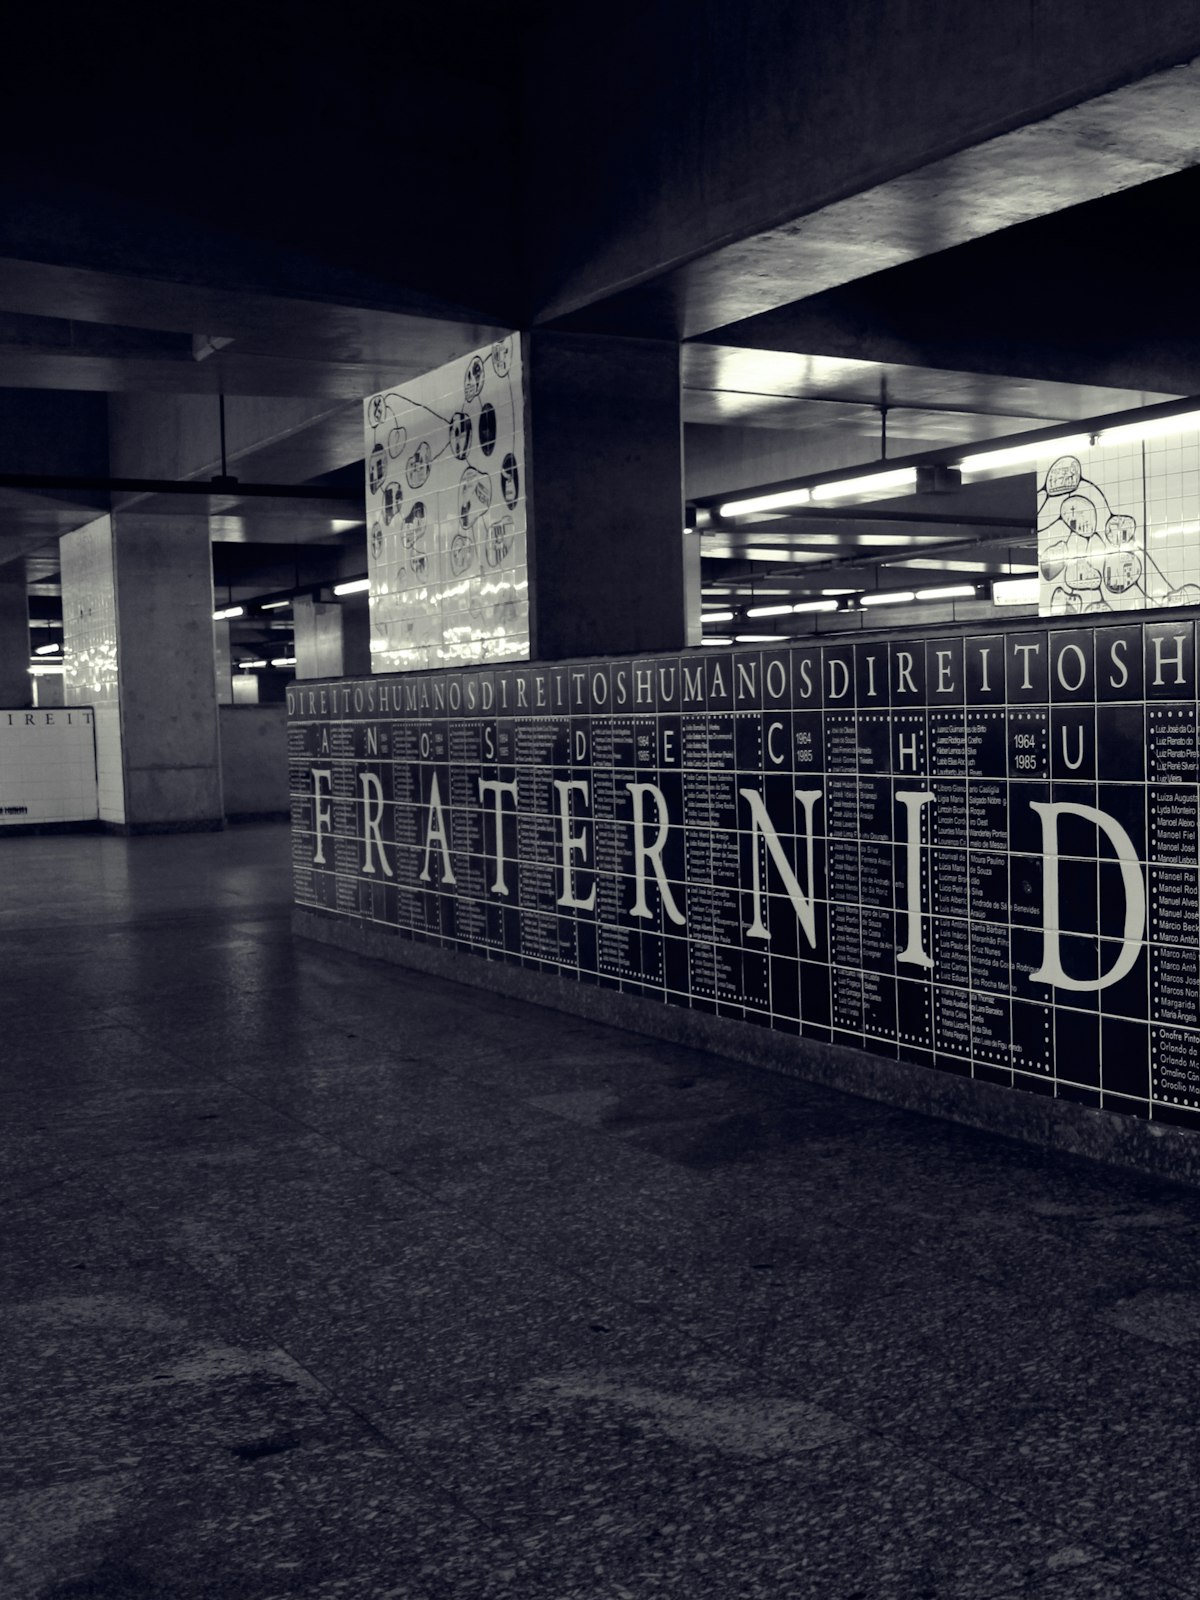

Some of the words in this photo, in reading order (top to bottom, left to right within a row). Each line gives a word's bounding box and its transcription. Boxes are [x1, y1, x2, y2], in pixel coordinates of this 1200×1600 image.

[796, 733, 812, 744] 1964
[1014, 734, 1035, 748] 1964
[796, 750, 813, 762] 1985
[1014, 755, 1036, 769] 1985
[1158, 871, 1182, 881] Manoel
[1159, 1029, 1182, 1042] Onofre
[1184, 1032, 1200, 1043] Pinto
